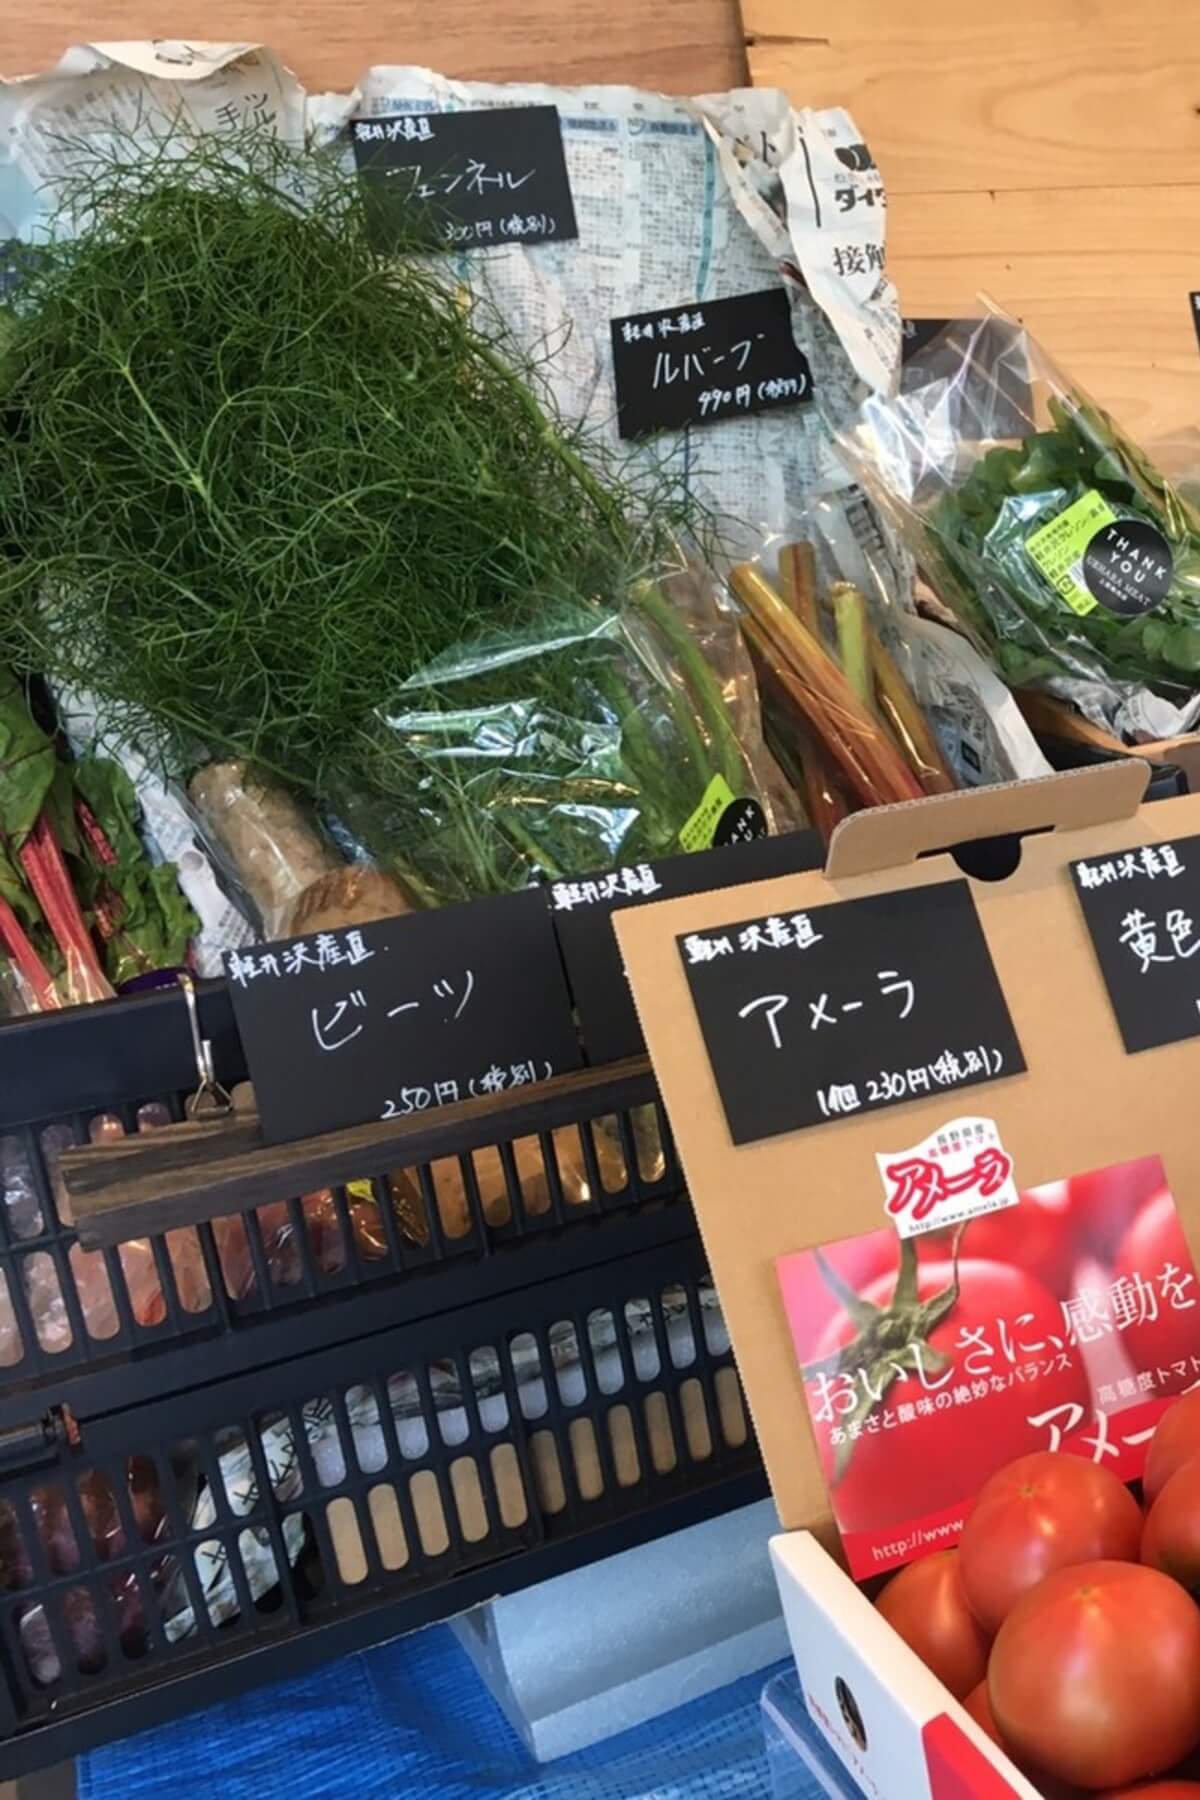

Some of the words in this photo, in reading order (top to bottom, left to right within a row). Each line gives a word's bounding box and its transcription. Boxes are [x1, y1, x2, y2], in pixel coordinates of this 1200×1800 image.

[386, 158, 537, 204] フェンネル
[652, 333, 766, 389] ルバーブ
[1106, 528, 1168, 580] THANK
[1110, 550, 1147, 584] YOU
[311, 969, 475, 1052] ビーツ
[738, 971, 915, 1049] アメーラ
[811, 1261, 1198, 1424] おいしさに、感動を
